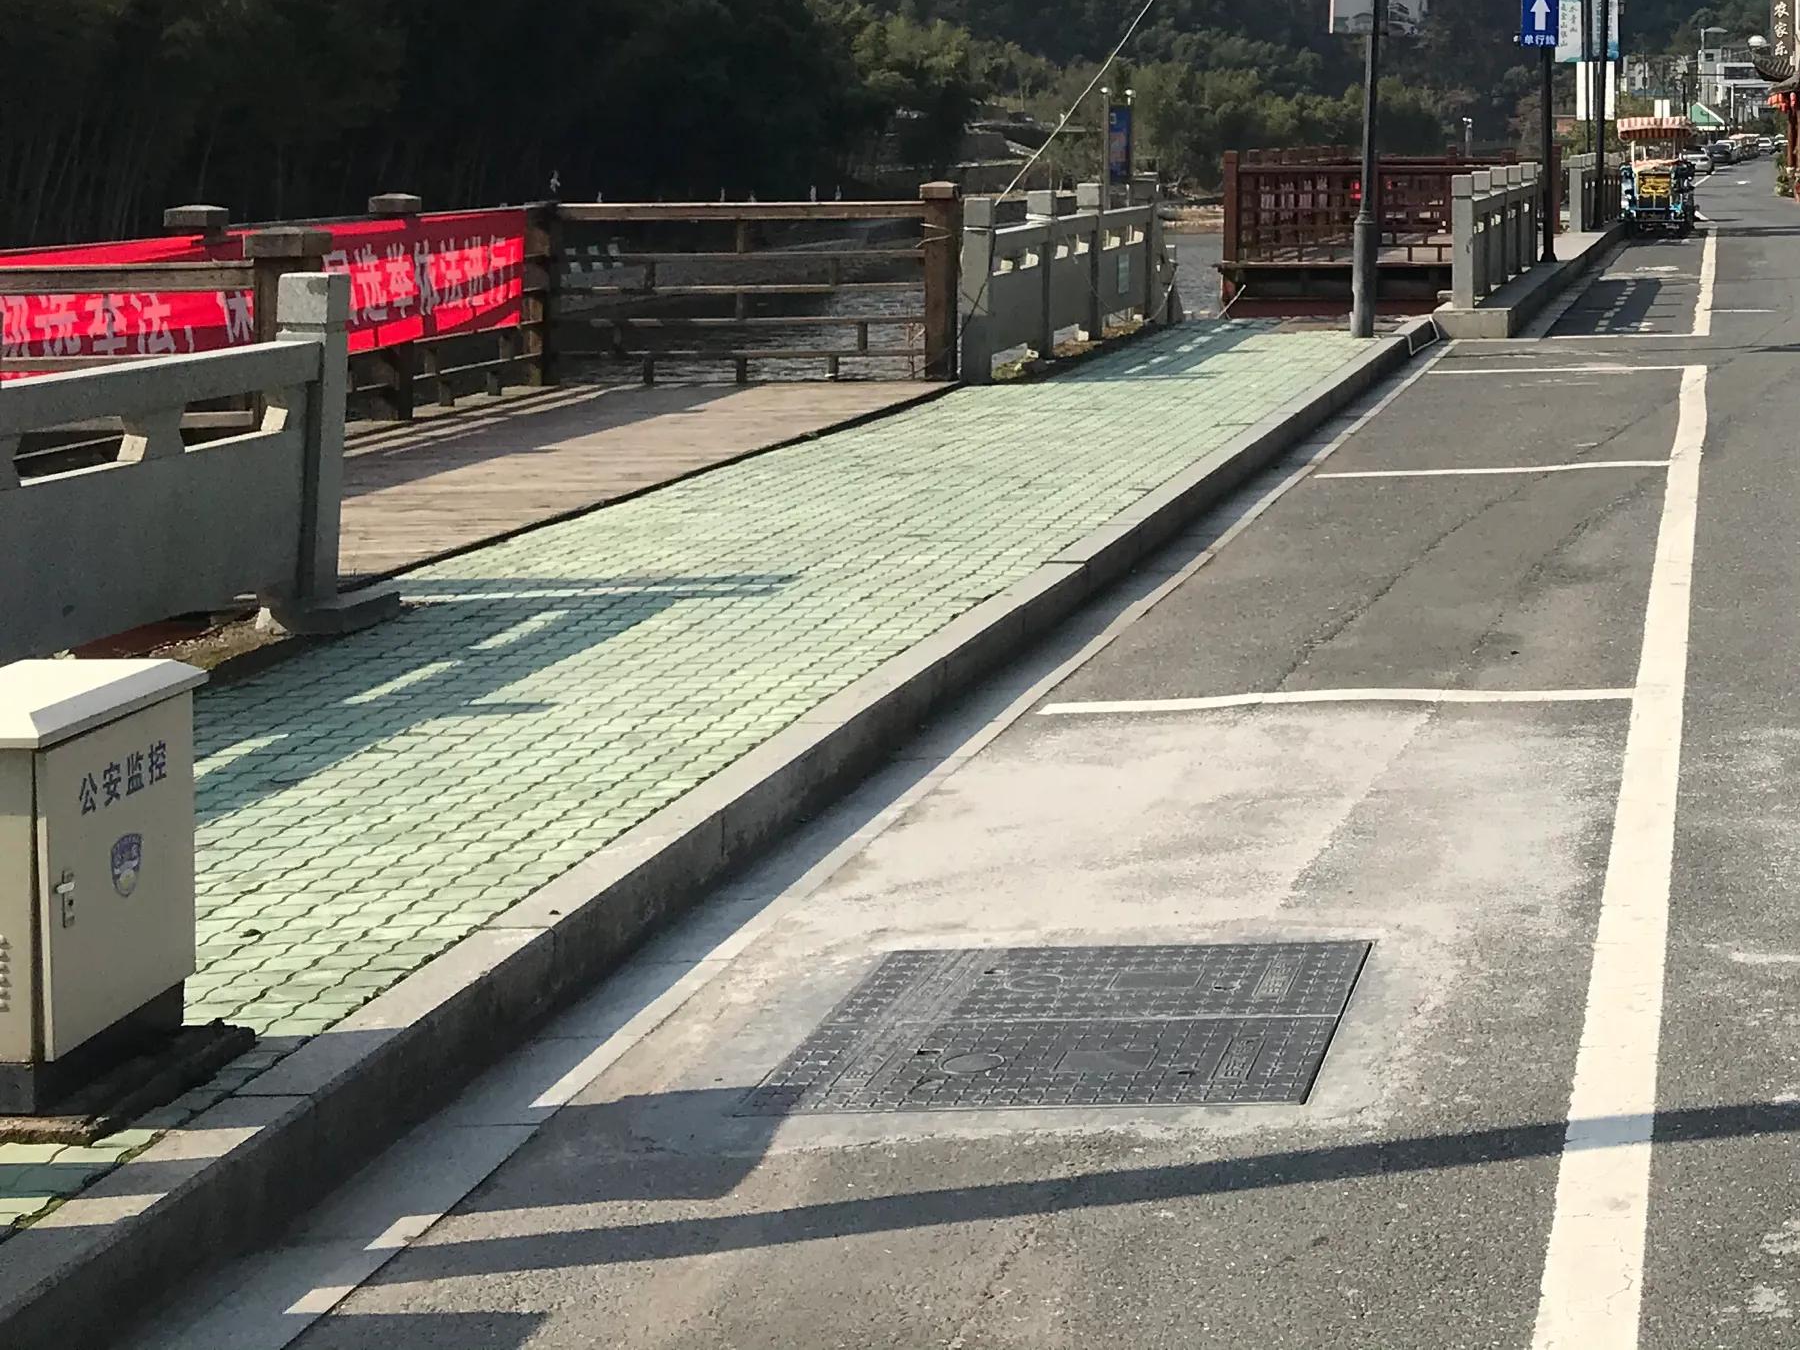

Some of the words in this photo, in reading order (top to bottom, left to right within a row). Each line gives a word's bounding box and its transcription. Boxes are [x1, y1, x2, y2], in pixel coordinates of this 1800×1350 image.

[1524, 34, 1556, 46] 单行线
[79, 740, 168, 816] 公安监控
